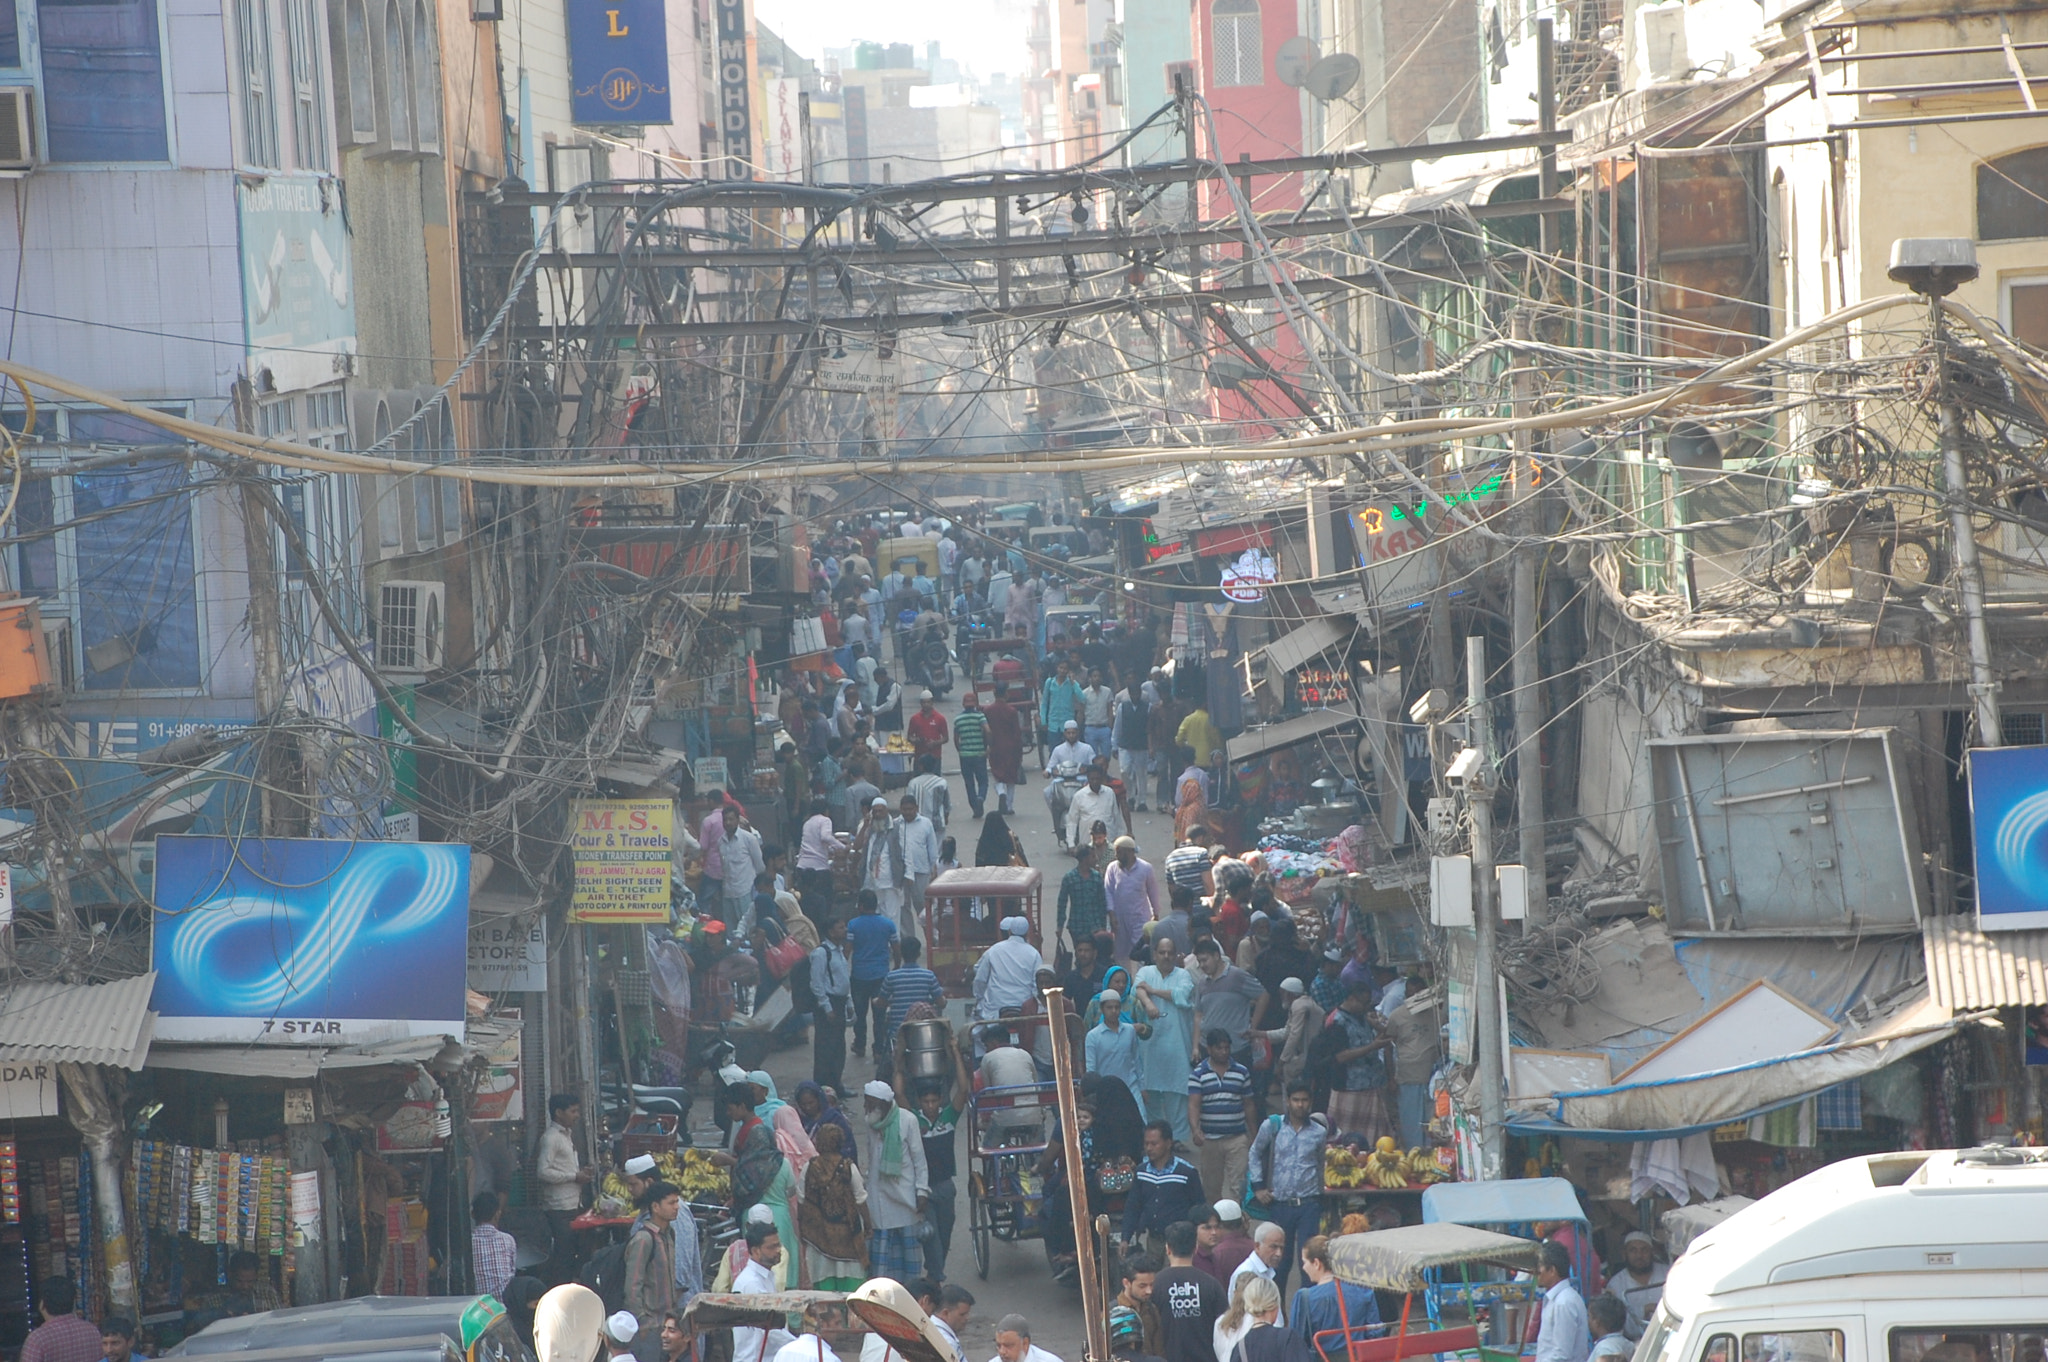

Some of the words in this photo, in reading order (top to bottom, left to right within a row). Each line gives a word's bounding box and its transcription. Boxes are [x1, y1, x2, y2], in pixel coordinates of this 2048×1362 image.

[274, 184, 311, 212] TRAVEL
[582, 810, 658, 831] M.S.
[605, 833, 615, 847] &
[620, 833, 669, 847] Travels
[579, 851, 605, 861] MONEY
[607, 851, 642, 861] TRANSFER
[645, 851, 667, 861] POINT
[599, 867, 628, 876] JAMMU,
[631, 867, 643, 876] TAJ
[646, 867, 667, 876] AGRA
[605, 877, 634, 886] SIGHT
[637, 877, 663, 886] SEEN
[621, 886, 663, 894] TICKET
[596, 902, 617, 910] COPY
[627, 902, 650, 910] PRINT
[652, 902, 667, 910] OUT
[468, 946, 527, 959] STORE
[263, 1021, 275, 1033] 7
[283, 1021, 341, 1034] STAR
[1169, 1295, 1200, 1310] food
[1171, 1308, 1201, 1318] WALKS
